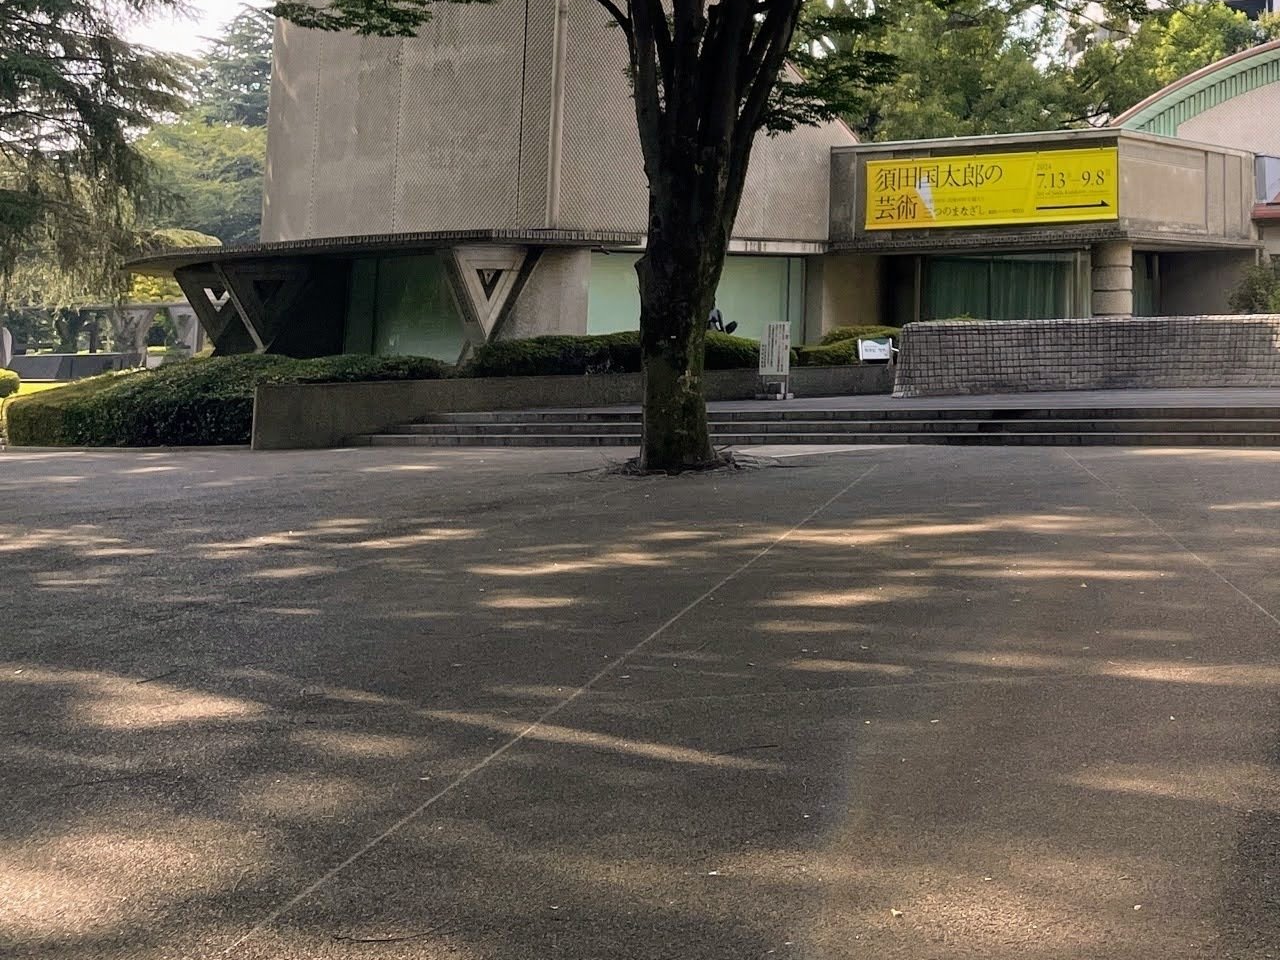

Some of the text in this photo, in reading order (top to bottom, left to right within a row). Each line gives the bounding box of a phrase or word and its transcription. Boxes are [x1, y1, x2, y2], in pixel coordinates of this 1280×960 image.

[874, 163, 1003, 193] 須田国太郎の
[874, 193, 918, 220] 芸術
[923, 204, 985, 219] 三つのまなざし
